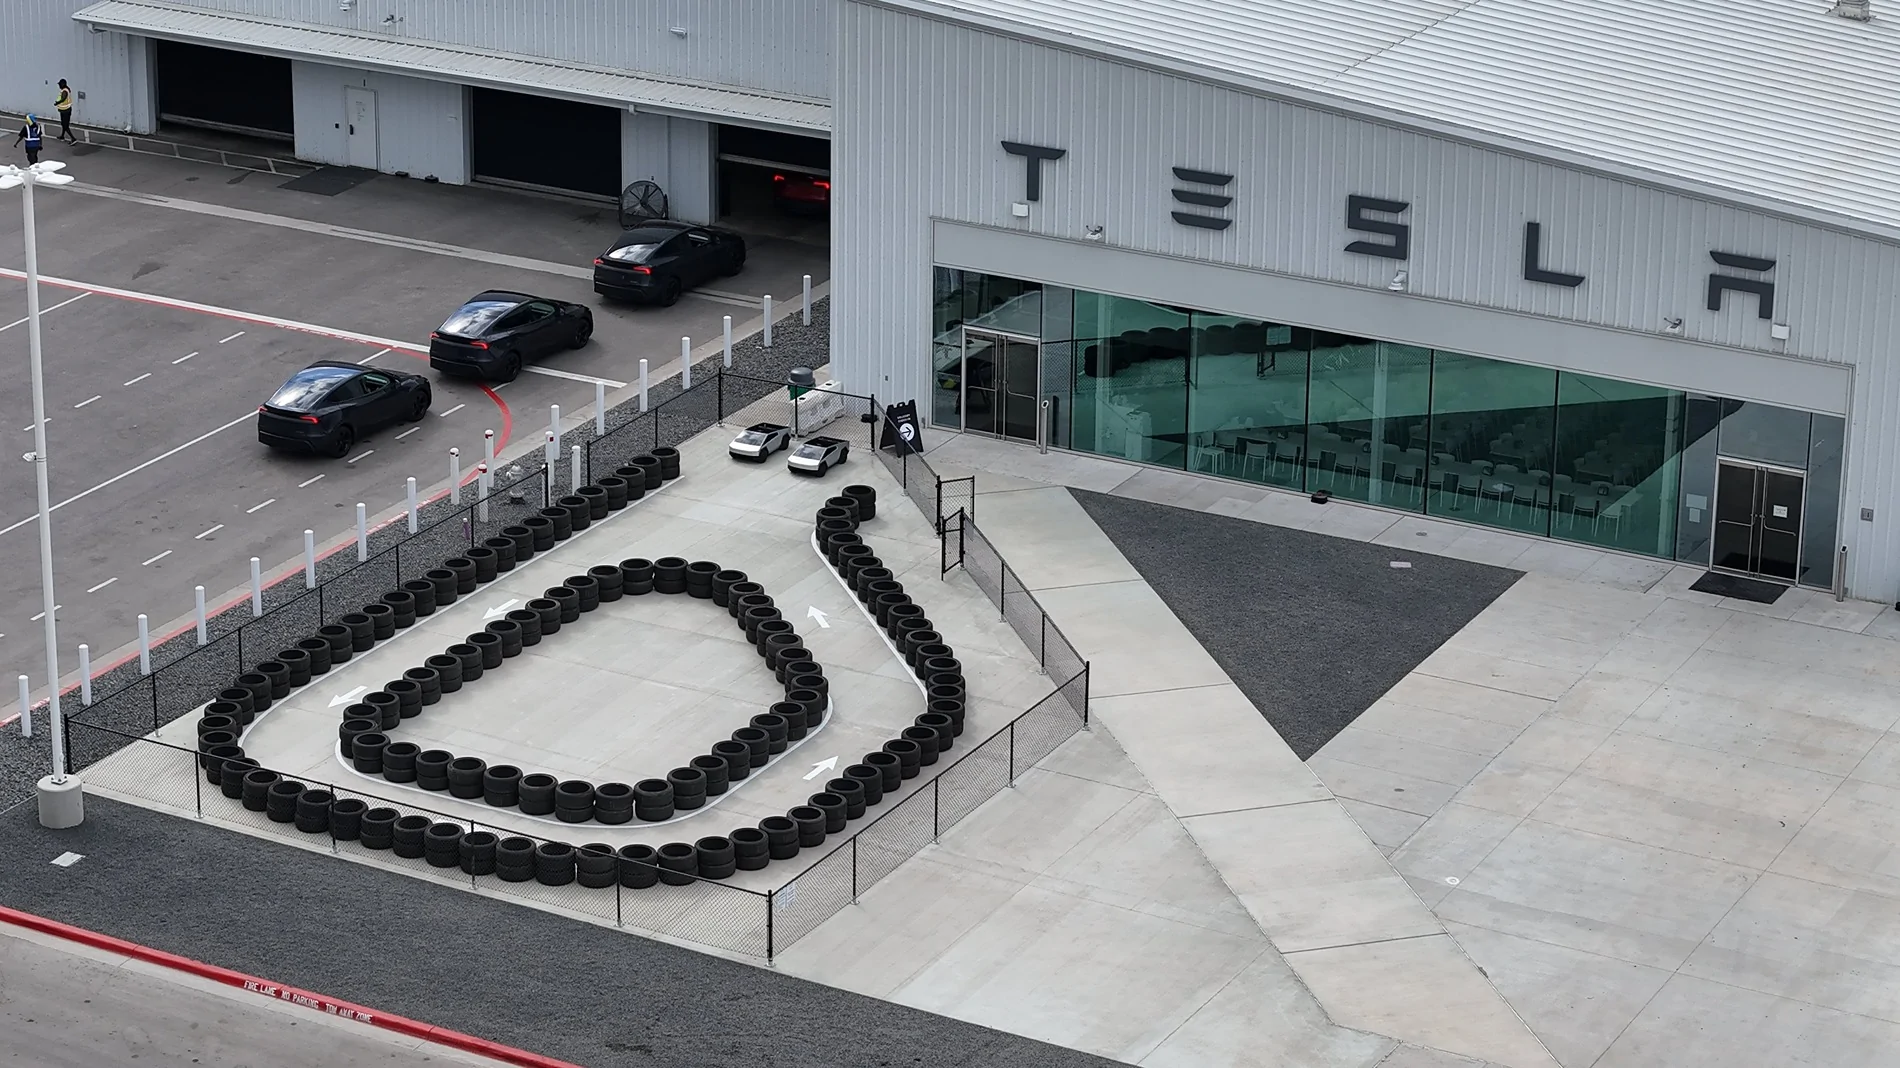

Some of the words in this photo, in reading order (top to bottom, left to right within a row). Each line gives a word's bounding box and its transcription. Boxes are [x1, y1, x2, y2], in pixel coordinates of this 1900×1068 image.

[1001, 140, 1776, 319] TESLA
[244, 980, 259, 992] FIRE
[260, 984, 277, 996] LANE
[281, 990, 291, 1000] NO
[292, 994, 319, 1009] PARKING
[325, 1003, 338, 1014] TOW
[339, 1007, 355, 1018] AWAY
[355, 1012, 373, 1024] ZONE
